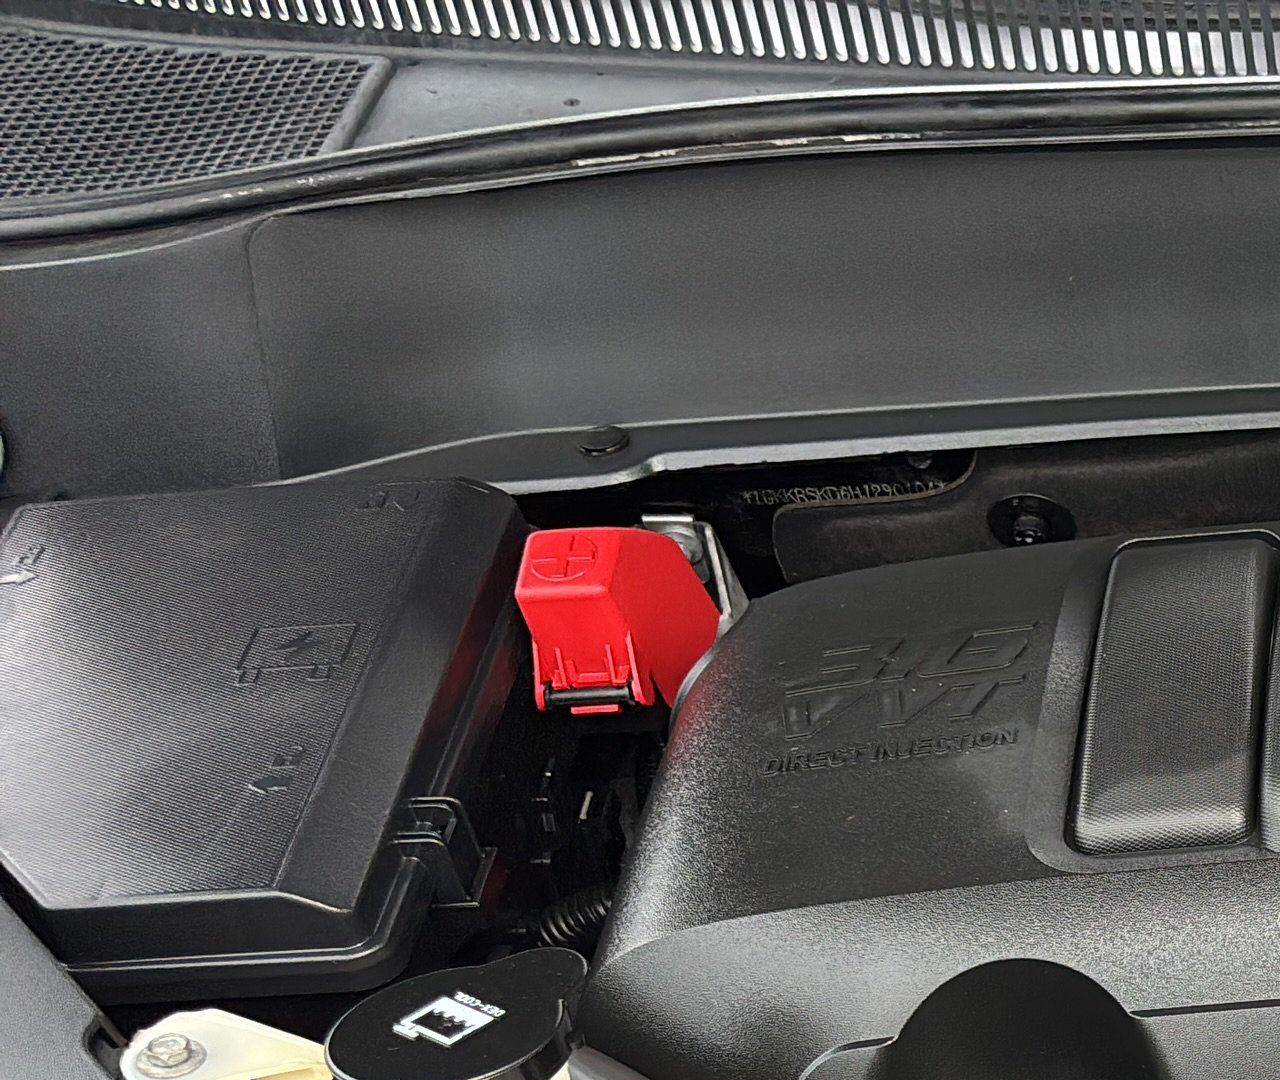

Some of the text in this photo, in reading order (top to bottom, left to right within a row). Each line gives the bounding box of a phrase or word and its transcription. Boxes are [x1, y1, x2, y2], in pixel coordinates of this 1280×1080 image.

[763, 727, 1019, 777] DIRECT INJECTION
[454, 989, 507, 1018] DEX-COOL
